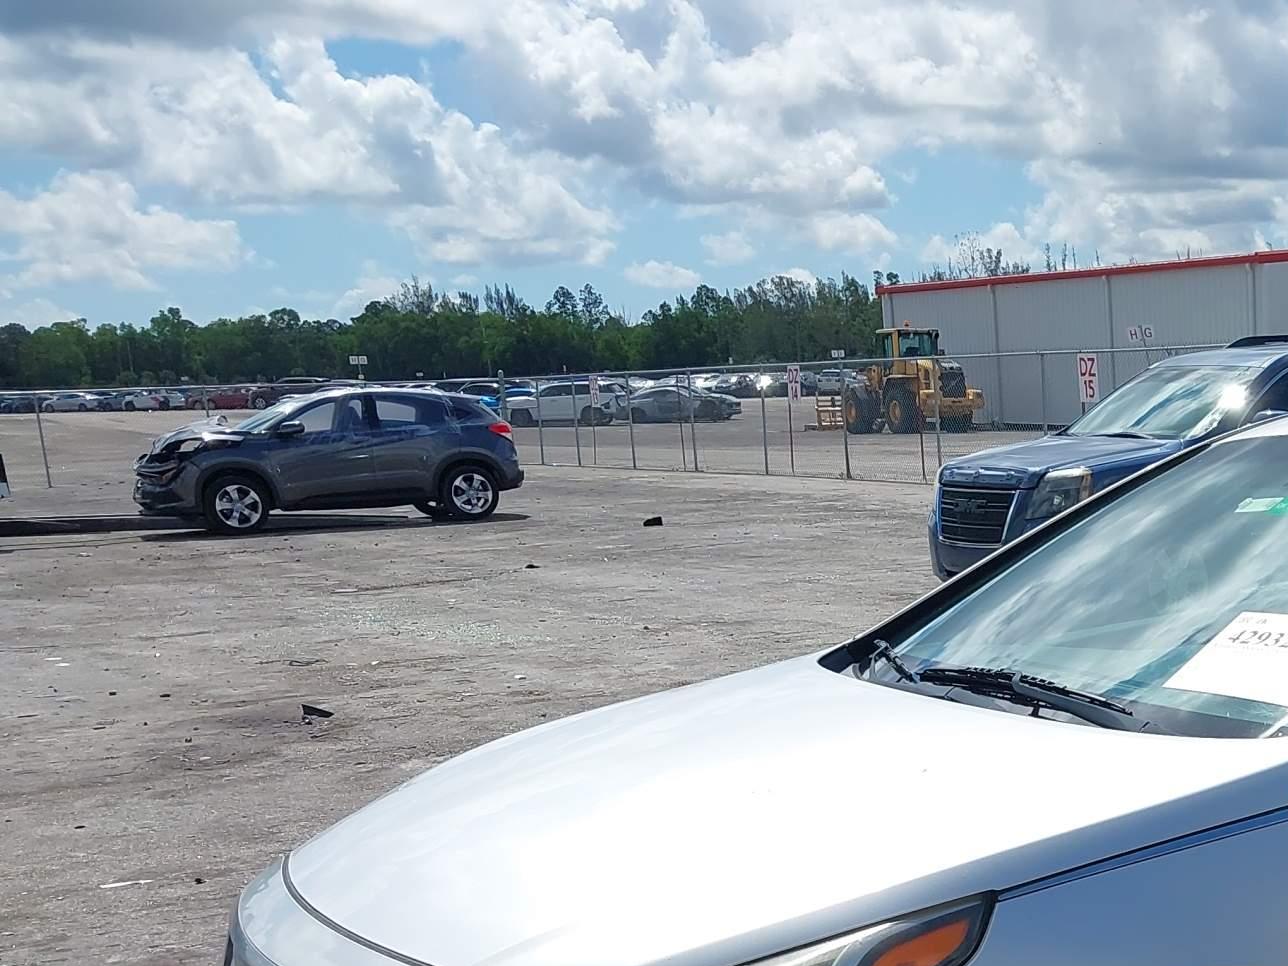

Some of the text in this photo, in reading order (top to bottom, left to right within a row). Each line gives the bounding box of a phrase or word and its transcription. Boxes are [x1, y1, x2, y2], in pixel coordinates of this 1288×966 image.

[1129, 328, 1138, 340] H
[1079, 357, 1096, 377] DZ
[788, 368, 799, 384] DZ
[1083, 379, 1095, 398] 15
